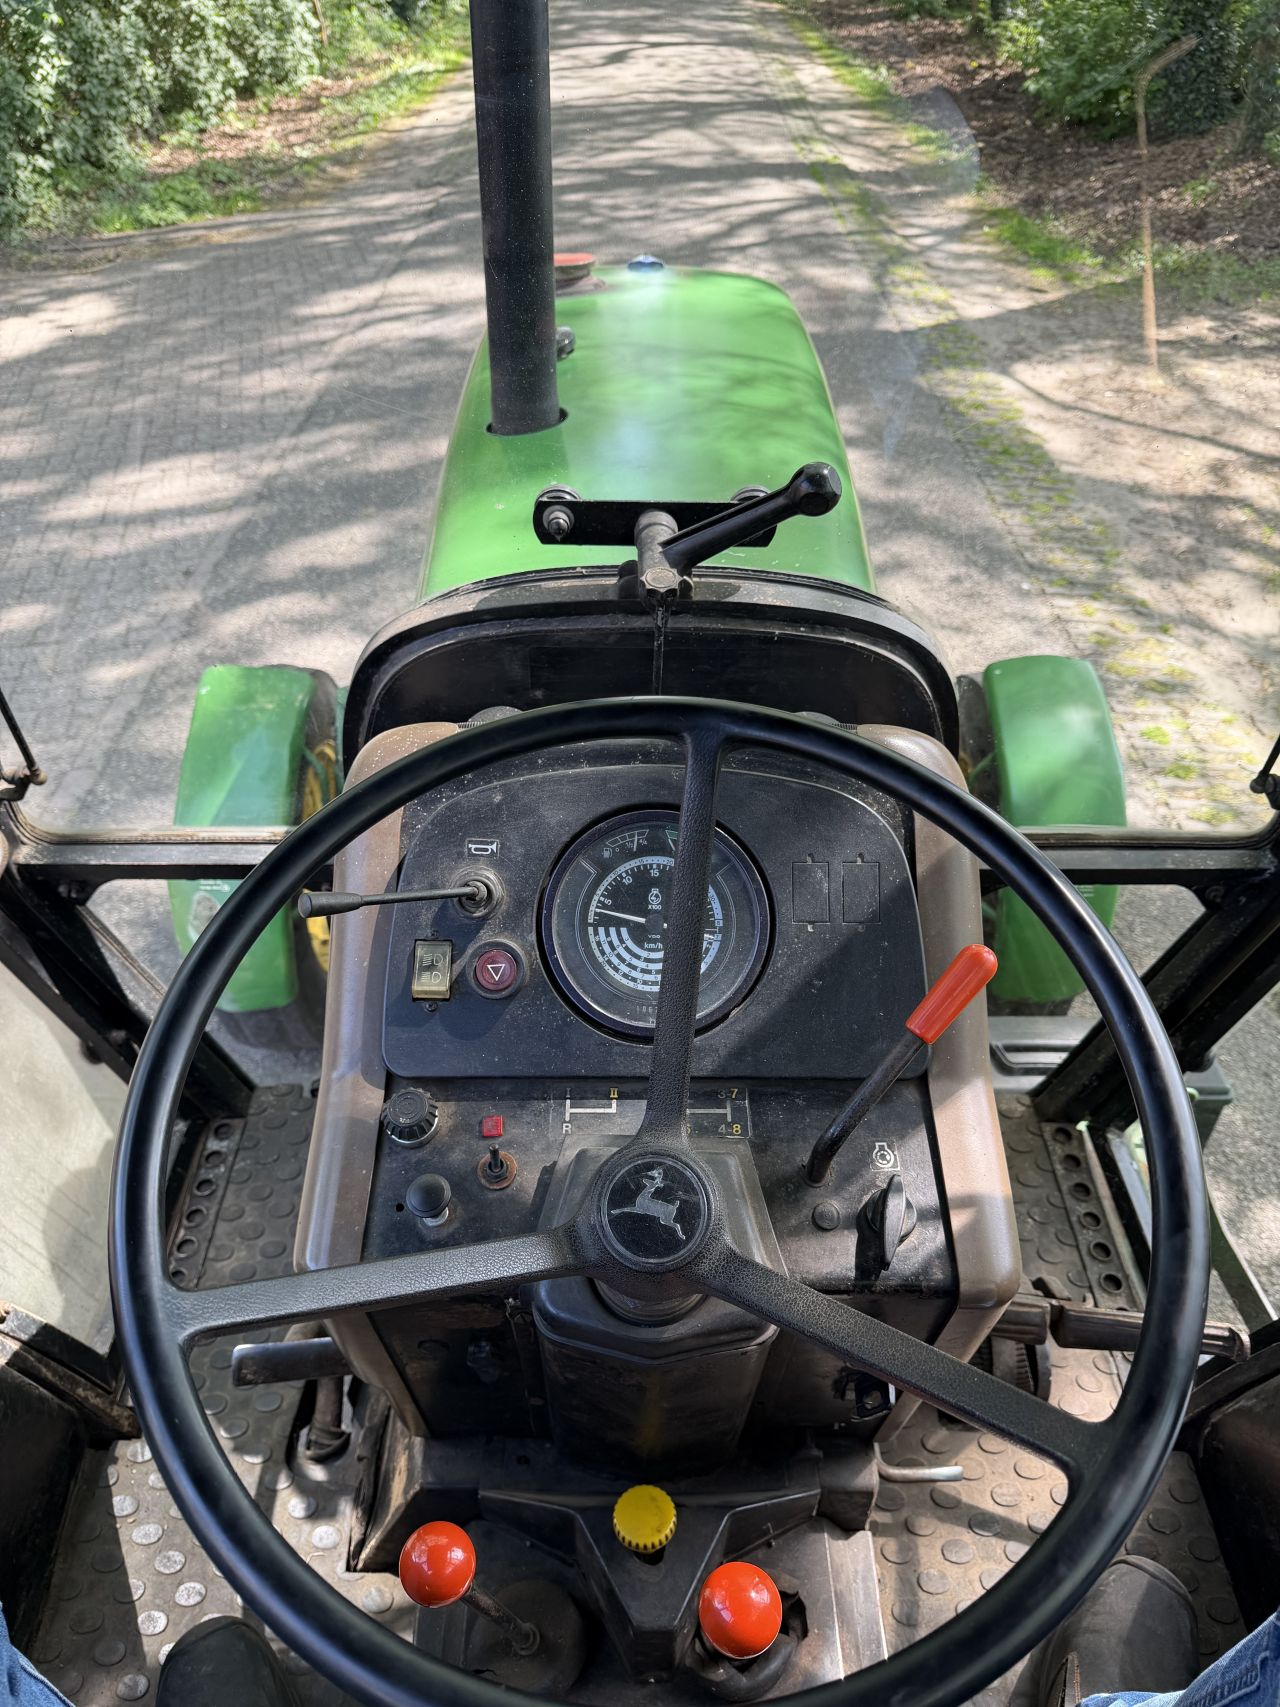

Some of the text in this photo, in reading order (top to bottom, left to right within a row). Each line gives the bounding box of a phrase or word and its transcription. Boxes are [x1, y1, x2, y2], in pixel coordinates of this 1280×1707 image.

[622, 876, 633, 885] 10
[610, 1088, 619, 1098] II
[718, 1088, 738, 1098] 3-7
[562, 1124, 572, 1134] R
[718, 1124, 742, 1134] 4-8
